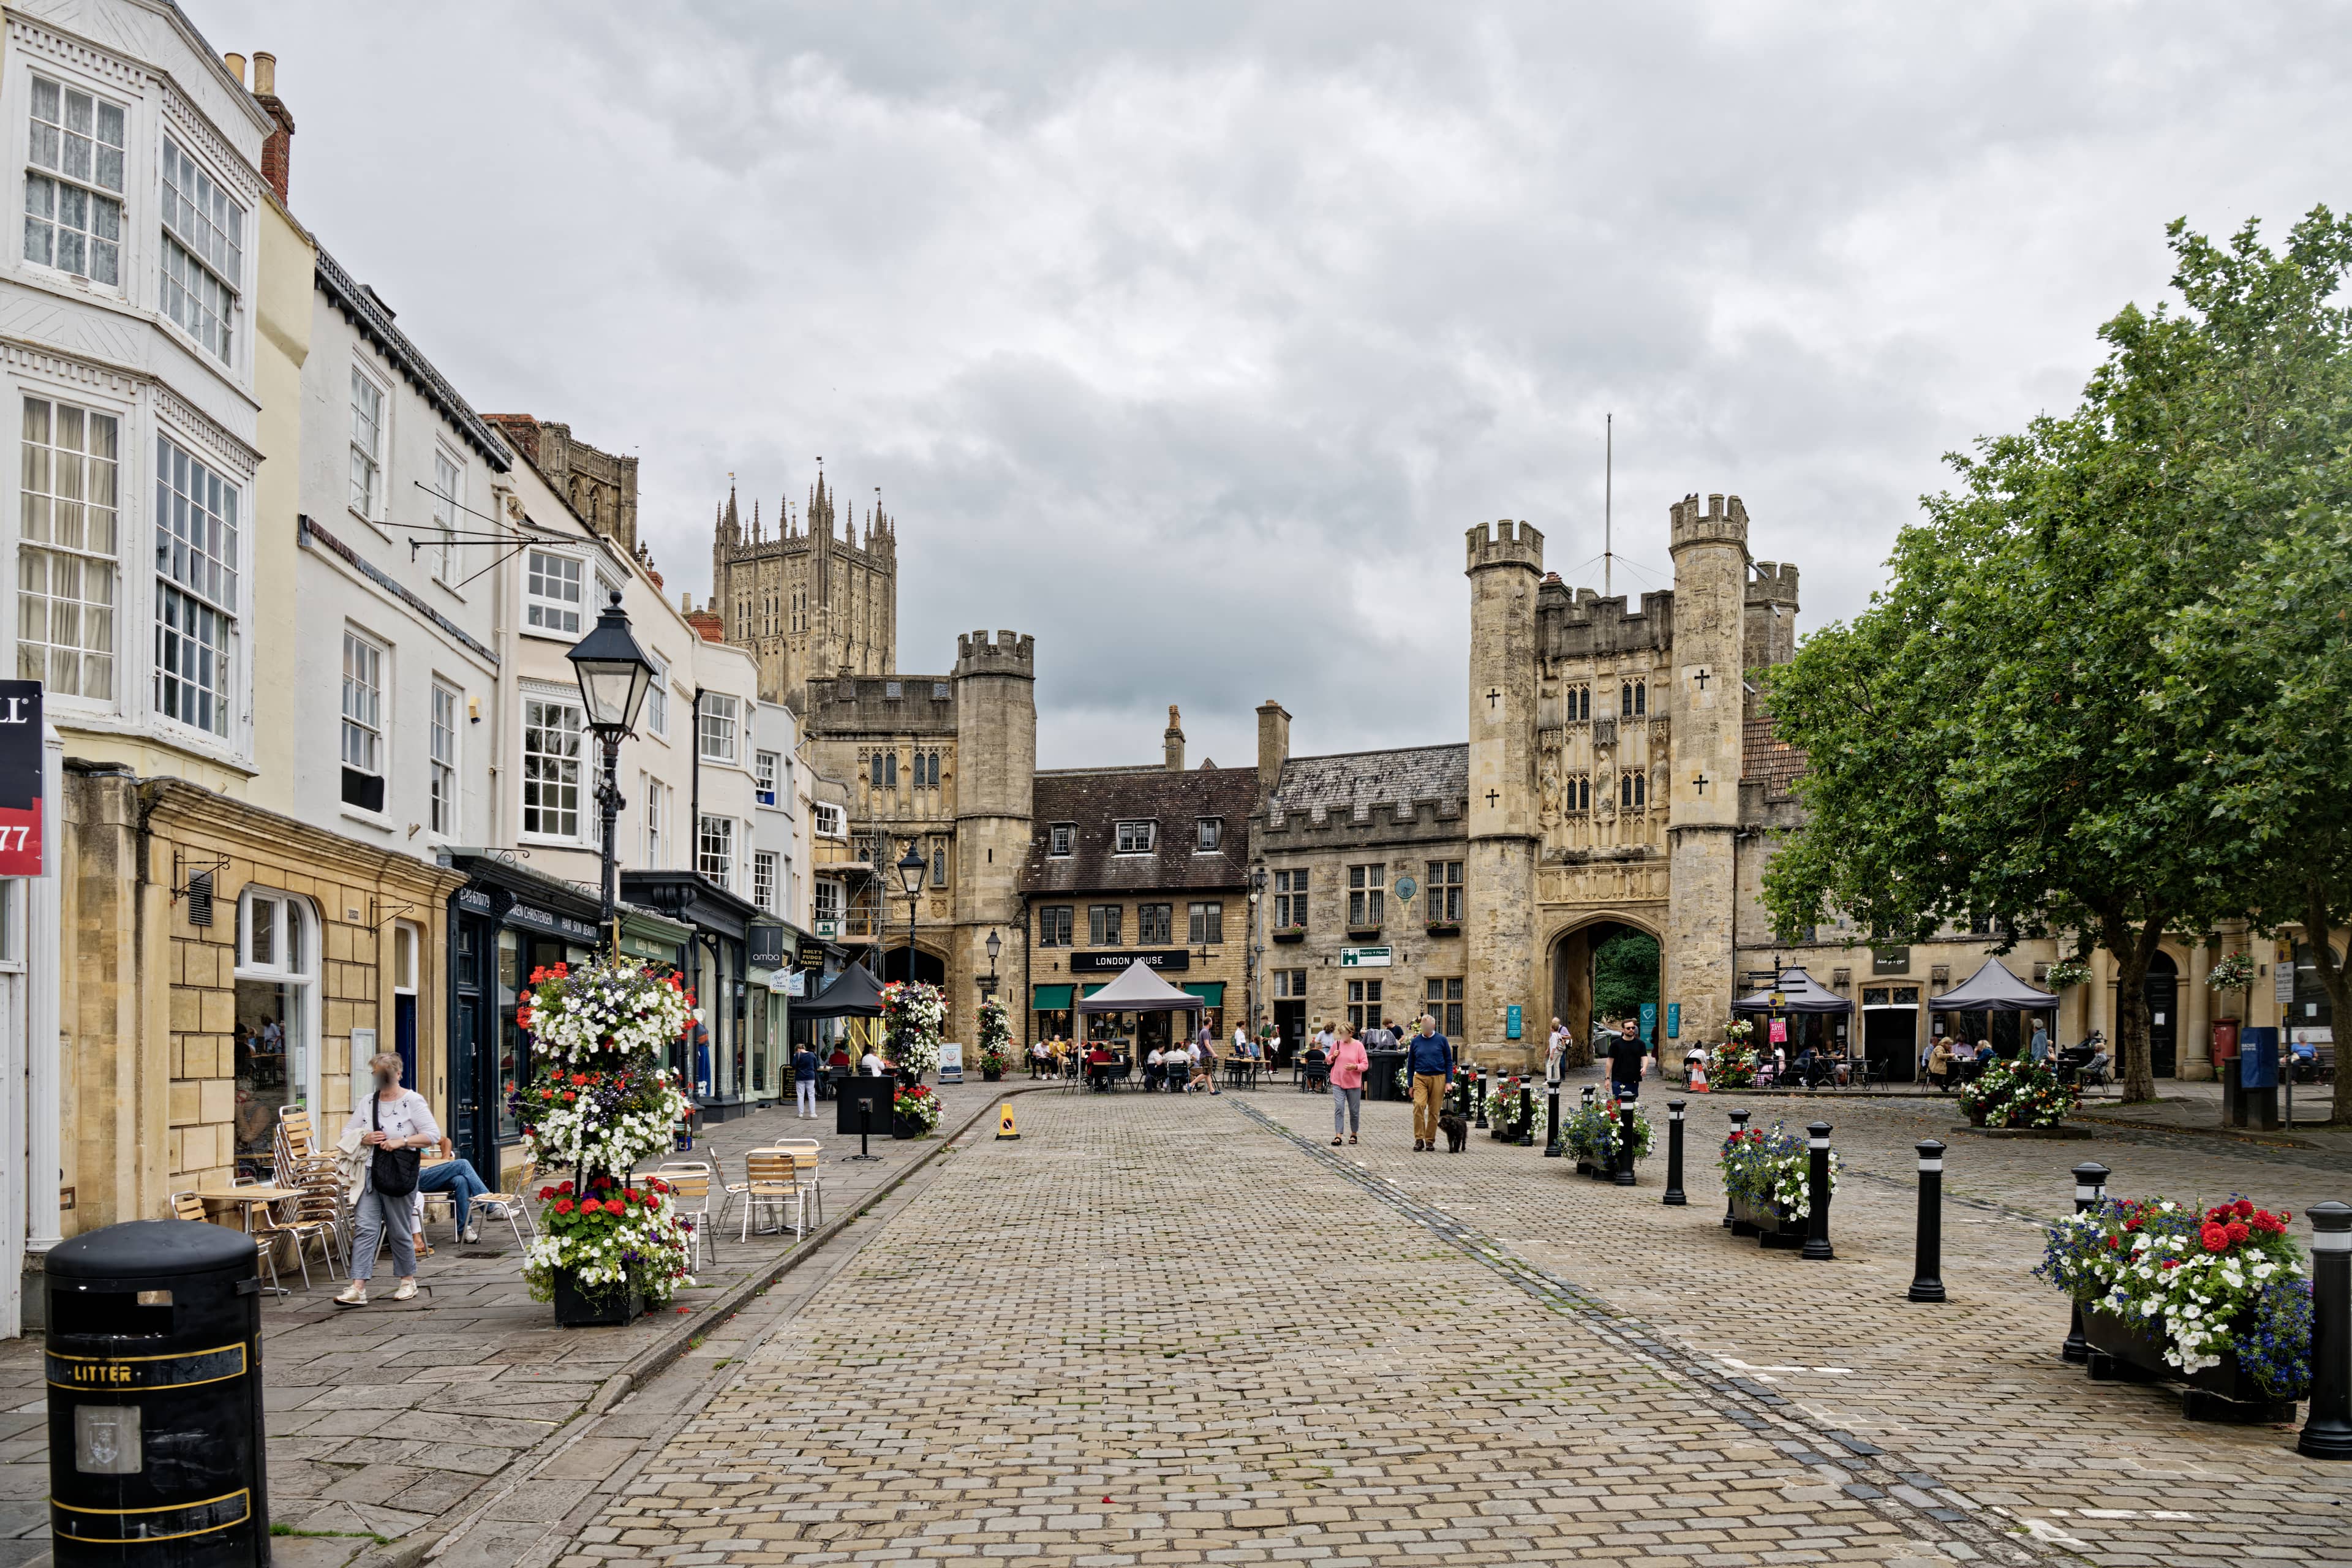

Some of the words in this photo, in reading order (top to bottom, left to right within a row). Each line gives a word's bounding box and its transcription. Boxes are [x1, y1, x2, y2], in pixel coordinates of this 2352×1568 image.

[472, 891, 490, 908] 670779
[509, 904, 523, 918] AREN
[524, 906, 553, 925] CHRISTENSEN
[562, 918, 571, 931] HAIR
[573, 921, 582, 933] SKIN
[582, 924, 597, 937] BEAUTY
[635, 938, 646, 954] Kitty
[648, 941, 662, 955] Banks
[753, 932, 780, 960] amba
[1096, 957, 1129, 965] LONDON
[75, 1365, 132, 1382] LITTER
